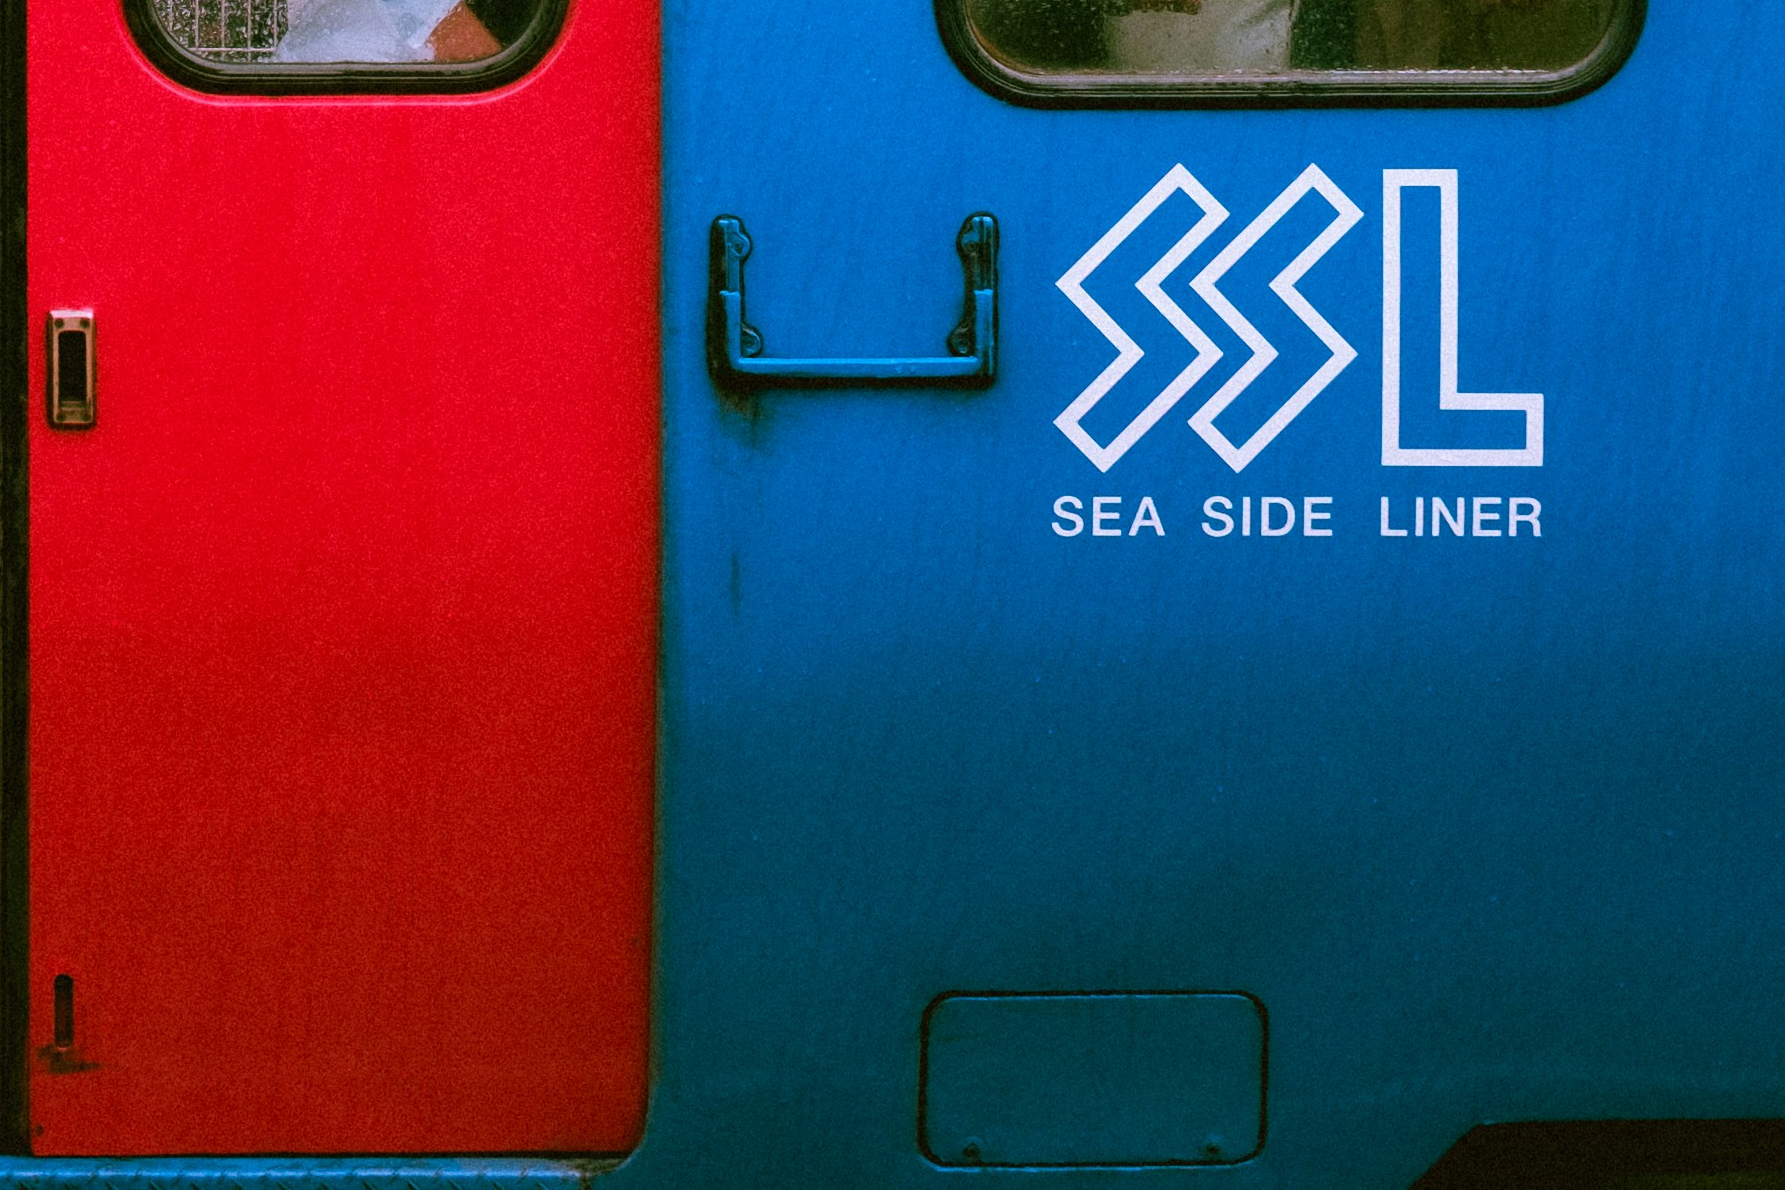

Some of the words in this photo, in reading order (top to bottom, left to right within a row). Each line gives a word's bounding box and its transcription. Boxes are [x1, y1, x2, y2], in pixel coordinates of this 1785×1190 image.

[1053, 162, 1545, 475] SSL
[1051, 495, 1166, 539] SEA
[1201, 495, 1334, 538] SIDE
[1379, 495, 1544, 538] LINER
